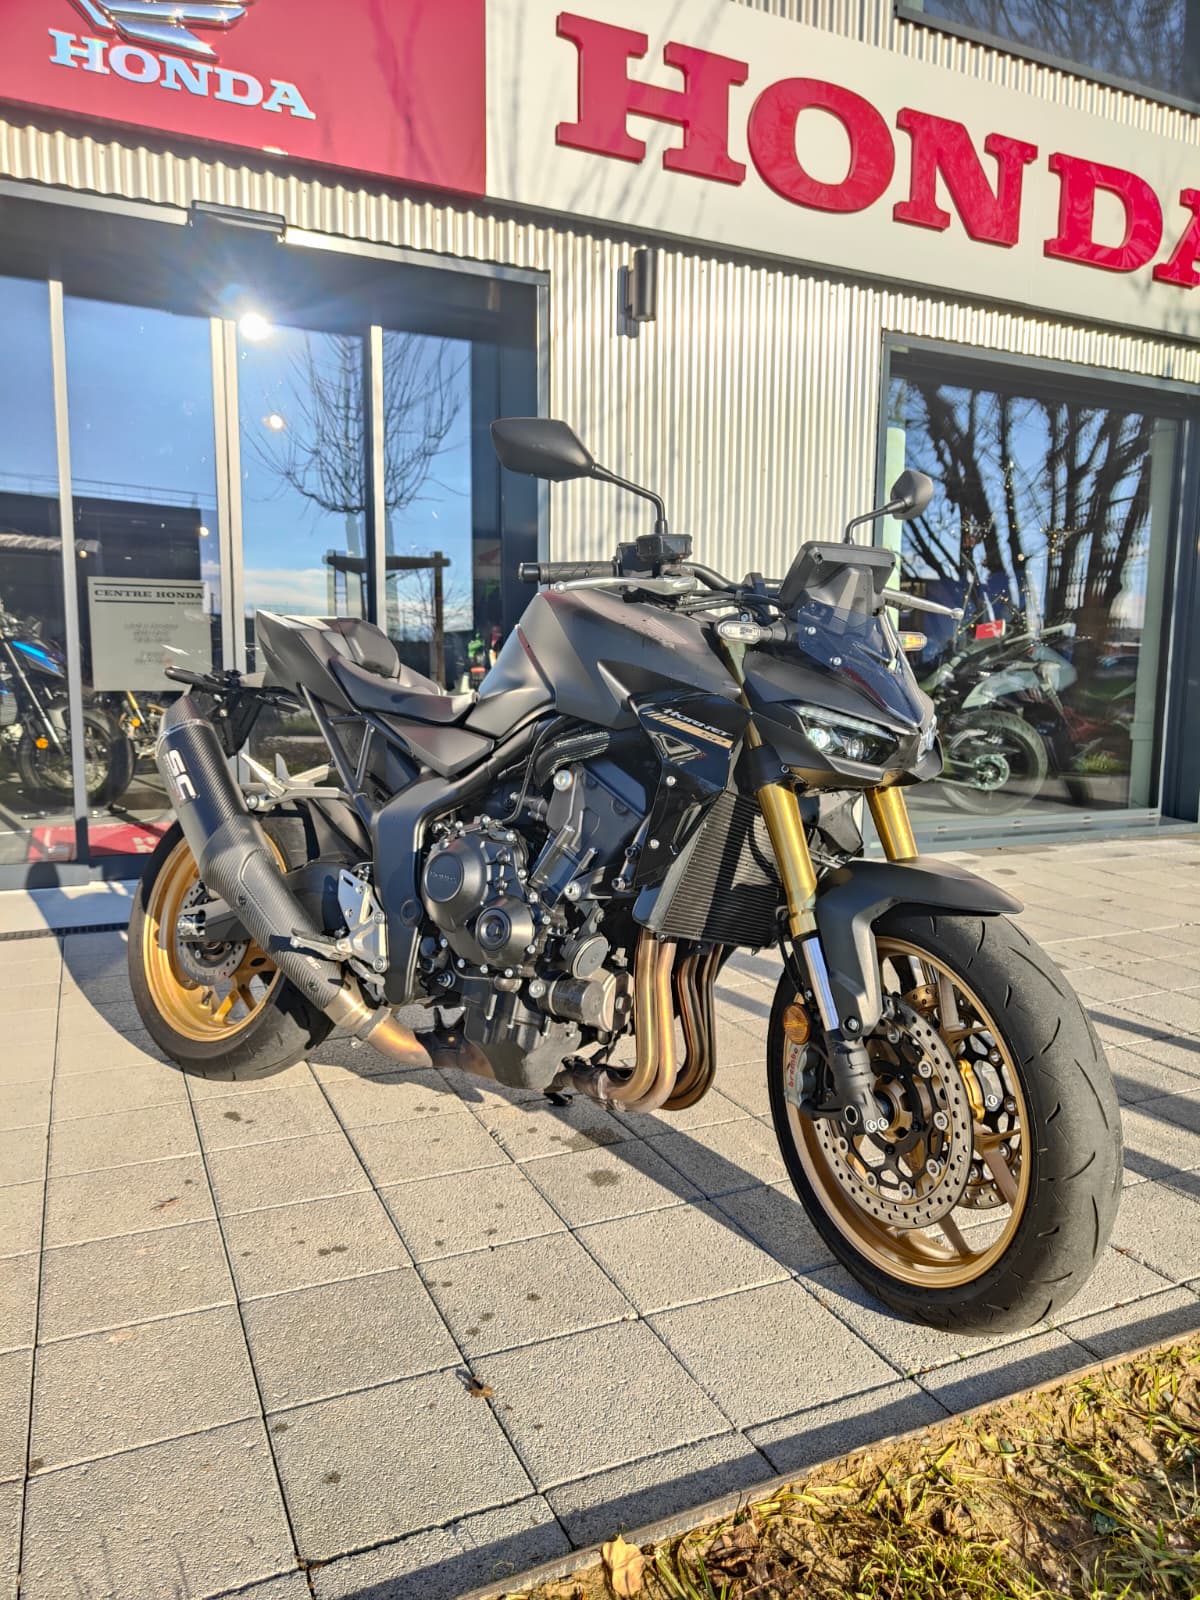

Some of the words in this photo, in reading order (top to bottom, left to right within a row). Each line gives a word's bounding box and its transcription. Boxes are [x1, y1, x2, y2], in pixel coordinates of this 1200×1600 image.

[48, 29, 316, 120] HONDA
[94, 589, 152, 598] CENTRE
[157, 591, 205, 599] HONDA
[788, 1047, 799, 1088] brembo
